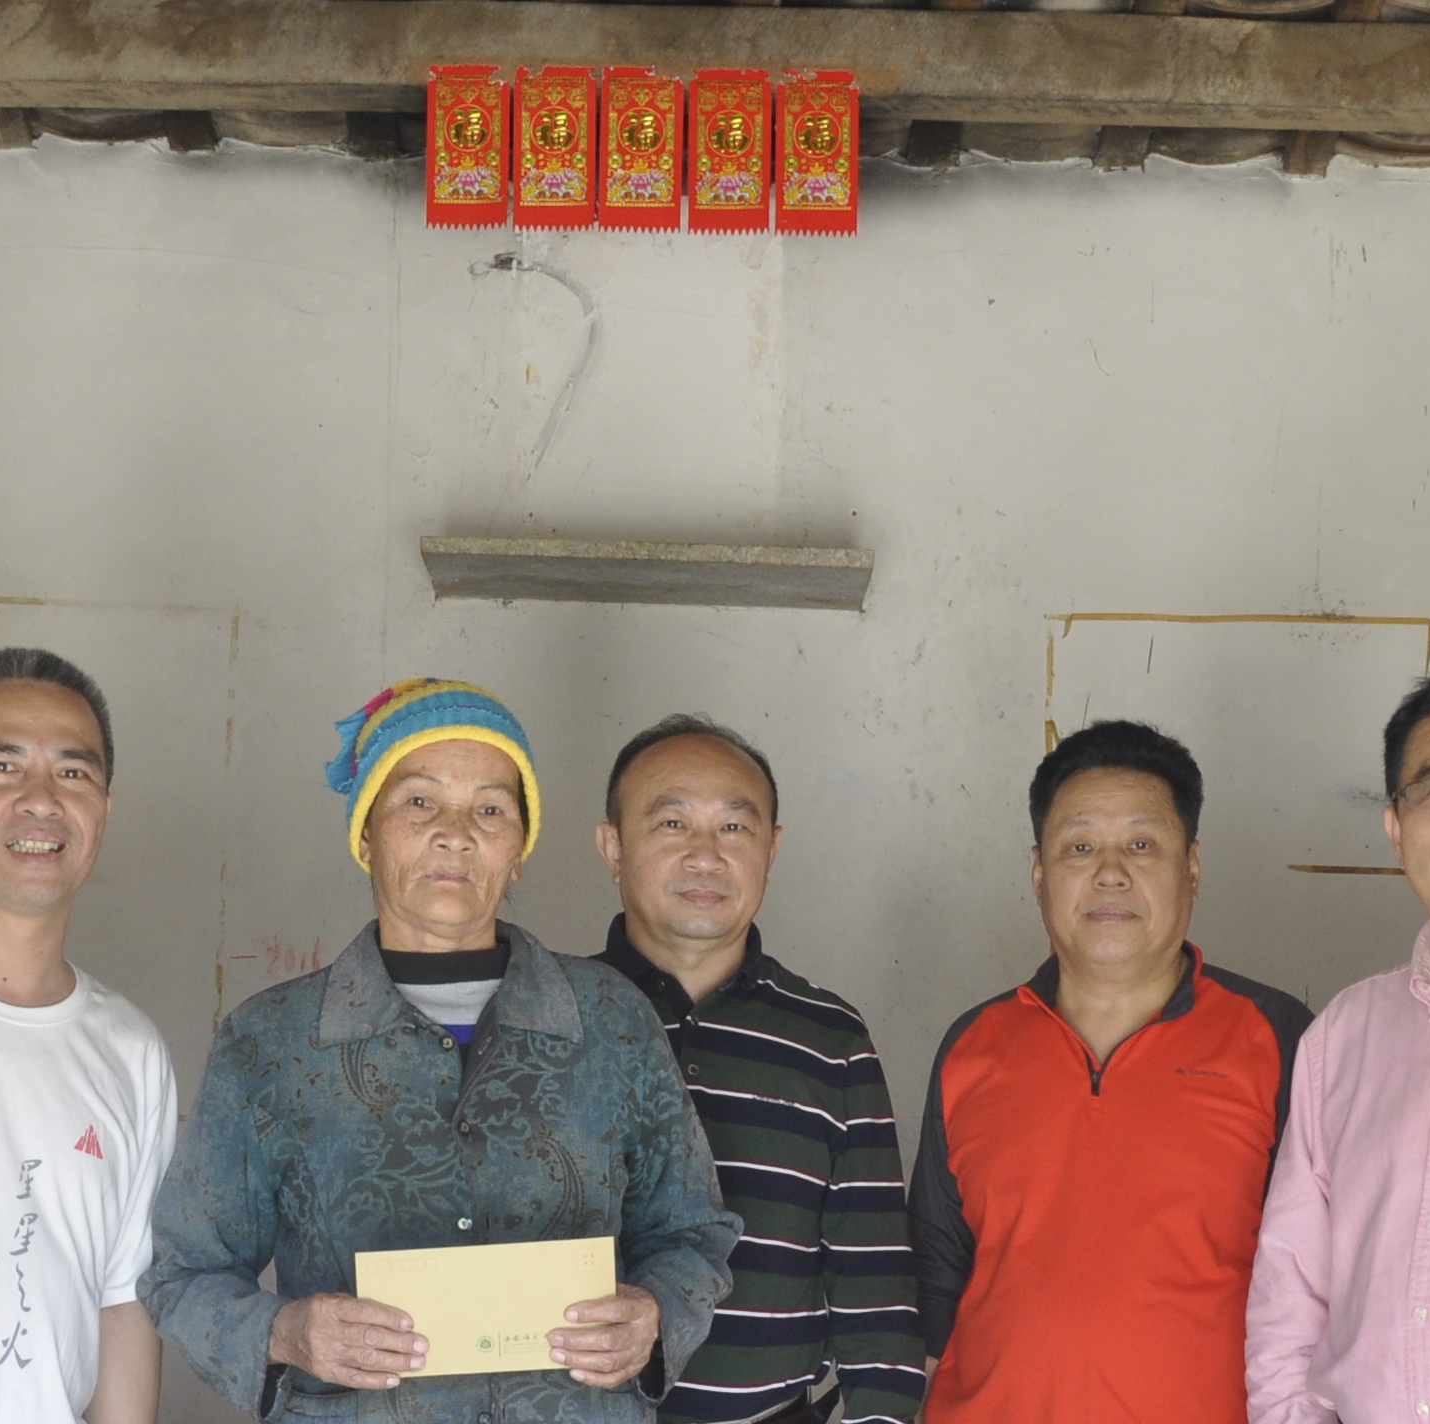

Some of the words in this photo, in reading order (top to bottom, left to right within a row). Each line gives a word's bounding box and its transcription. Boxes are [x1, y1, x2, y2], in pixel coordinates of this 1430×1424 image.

[449, 111, 487, 148] 福
[536, 112, 573, 150] 福
[623, 112, 660, 150] 福
[711, 114, 749, 153] 福
[799, 115, 836, 154] 福
